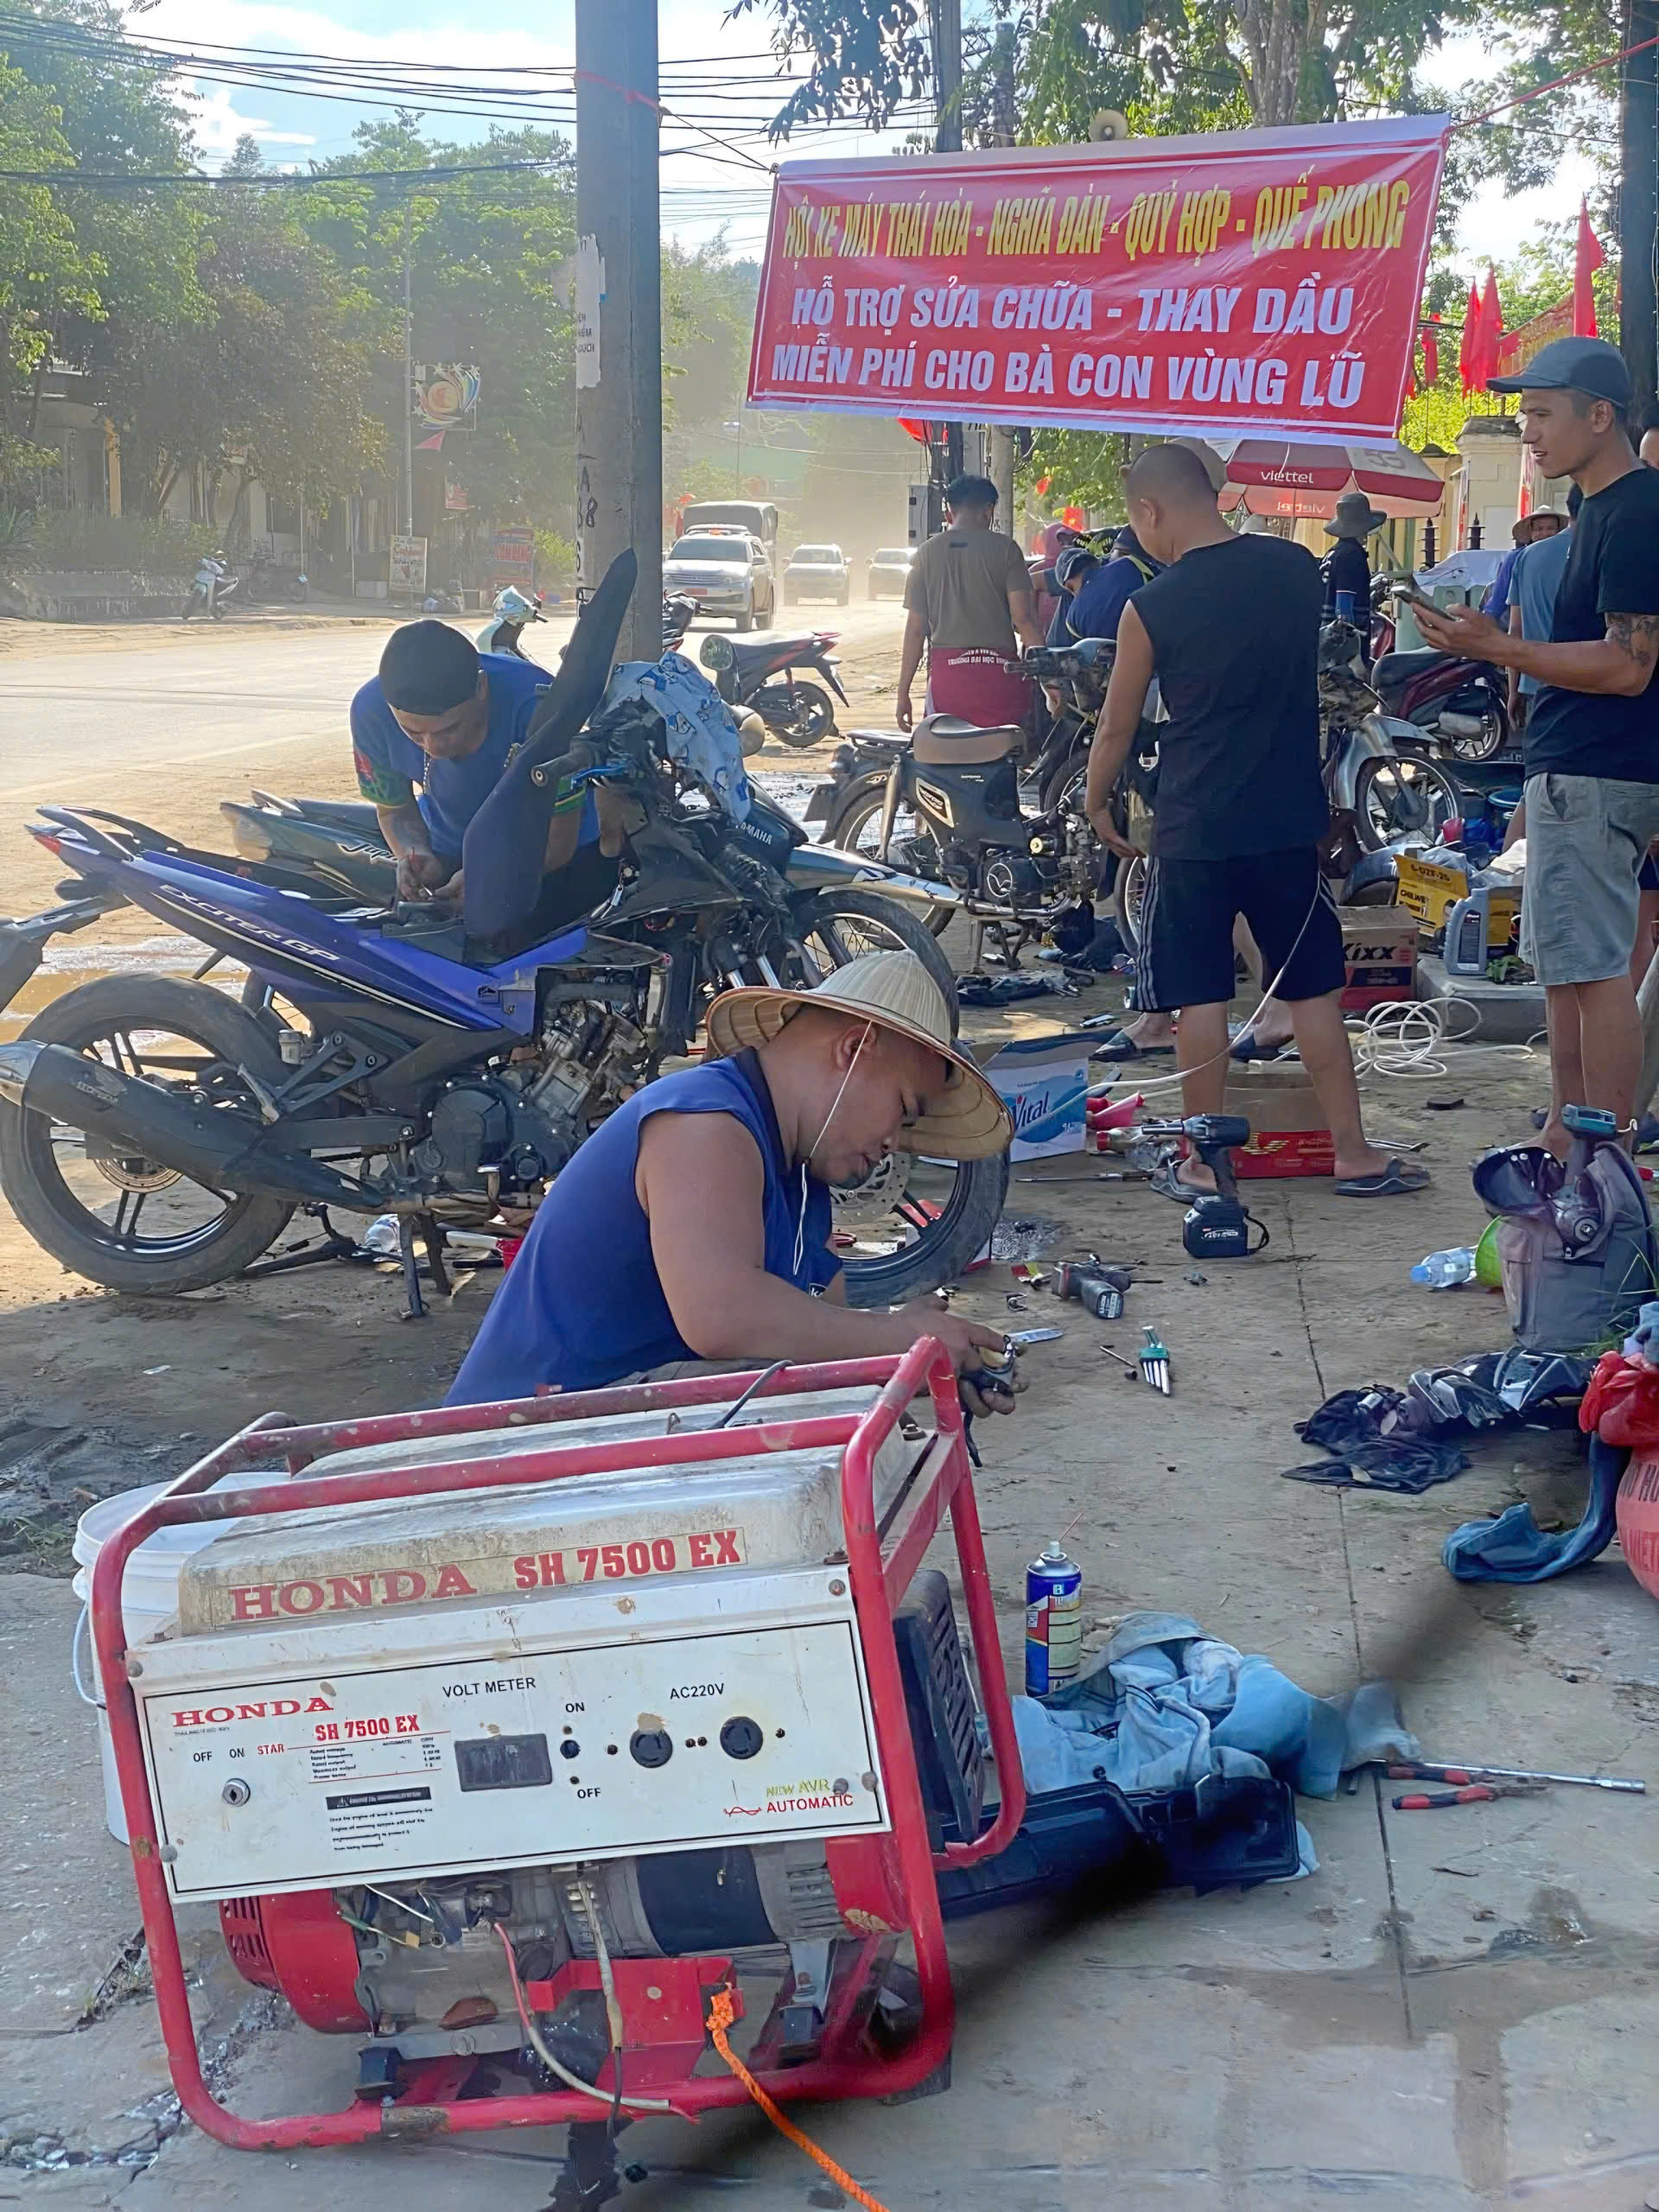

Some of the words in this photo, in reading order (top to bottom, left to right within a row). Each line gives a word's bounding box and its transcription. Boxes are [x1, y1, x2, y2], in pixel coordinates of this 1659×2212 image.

[838, 192, 885, 257] MÁY
[886, 189, 931, 257] THÁI
[987, 186, 1057, 255] NGHĨA
[1176, 183, 1231, 267] HỢP
[1253, 164, 1316, 259] QUẾ
[1303, 180, 1410, 250] PHONG
[791, 275, 835, 326] HỖ
[844, 284, 906, 335] TRỢ
[910, 275, 979, 328] SỬA
[992, 280, 1092, 331] CHỮA
[1137, 285, 1243, 333] THAY
[1253, 271, 1354, 335] DẦU
[772, 332, 853, 384] MIỄN
[858, 340, 917, 387] PHÍ
[924, 349, 995, 391] CHO
[1005, 343, 1055, 394] BÀ
[1067, 353, 1154, 398] CON
[1168, 347, 1288, 405] VÙNG
[1300, 351, 1366, 409] LŨ
[1261, 469, 1314, 485] viettel
[734, 821, 772, 846] AMAHA
[227, 1563, 478, 1621] HONDA
[513, 1552, 567, 1590] SH
[576, 1538, 677, 1582] 7500
[688, 1529, 741, 1568] EX
[442, 1683, 480, 1698] VOLT
[485, 1677, 537, 1694] METER
[670, 1682, 725, 1700] AC220V
[172, 1697, 334, 1727] HONDA
[565, 1701, 586, 1713] ON
[315, 1723, 340, 1742] SH
[344, 1718, 390, 1738] 7500
[395, 1714, 420, 1732] EX
[193, 1751, 213, 1763] OFF
[229, 1747, 245, 1758] ON
[576, 1788, 602, 1799] OFF
[766, 1795, 855, 1813] AUTOMATIC
